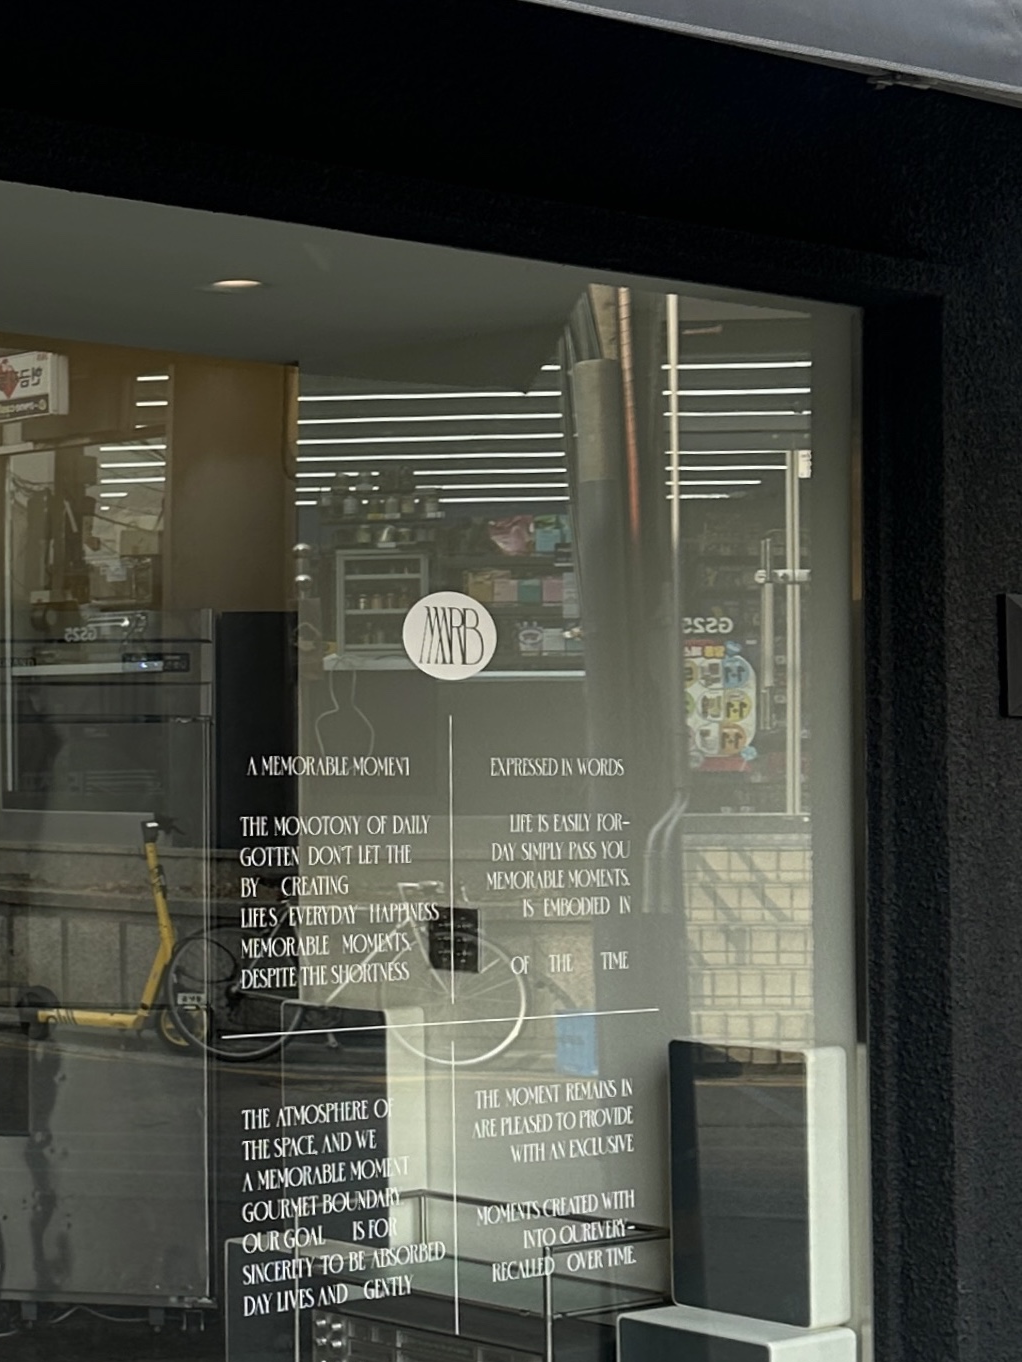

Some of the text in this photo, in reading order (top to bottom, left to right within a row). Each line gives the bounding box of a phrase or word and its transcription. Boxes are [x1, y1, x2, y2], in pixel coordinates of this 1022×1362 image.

[247, 755, 410, 776] A MEMORABLE MOMENT
[490, 757, 625, 777] EXPRESSED IN WORDS
[239, 815, 431, 836] THE MONOTONY OF DAILY
[510, 812, 631, 833] LIFE IS EASILY FOR-
[239, 844, 412, 867] GOTTEN DON'T LET THE
[491, 840, 631, 861] DAY SIMPLY PASS YOU
[240, 875, 349, 898] BY CREATING
[486, 870, 565, 890] MEMORABLE
[288, 904, 358, 927] EVERYDAY
[370, 902, 440, 924] HAPPINESS
[523, 896, 631, 917] IS EMBODIED IN
[241, 935, 329, 959] MEMORABLE
[241, 961, 410, 990] DESPITE THE SHORTNESS
[510, 951, 629, 974] OF THE TIME
[475, 1078, 633, 1109] THE MOMENT REMAINS IN
[242, 1098, 394, 1130] THE ATMOSPHERE OF
[472, 1106, 634, 1139] ARE PLEASED TO PROVIDE
[242, 1129, 377, 1161] THE SPACE, AND WE
[510, 1134, 634, 1163] WITH AN EXCLUSIVE
[242, 1155, 410, 1192] A MEMORABLE MOMENT
[242, 1195, 318, 1223] GOURMET
[477, 1189, 635, 1226] MOMENTS CREATED WITH
[242, 1217, 397, 1254] OUR GOAL IS FOR
[523, 1227, 556, 1249] INTO
[242, 1241, 446, 1285] SINCERITY TO BE ABSORBED
[492, 1245, 636, 1282] RECALLED OVER TIME.
[244, 1274, 414, 1317] DAY LIVES AND GENTLY
